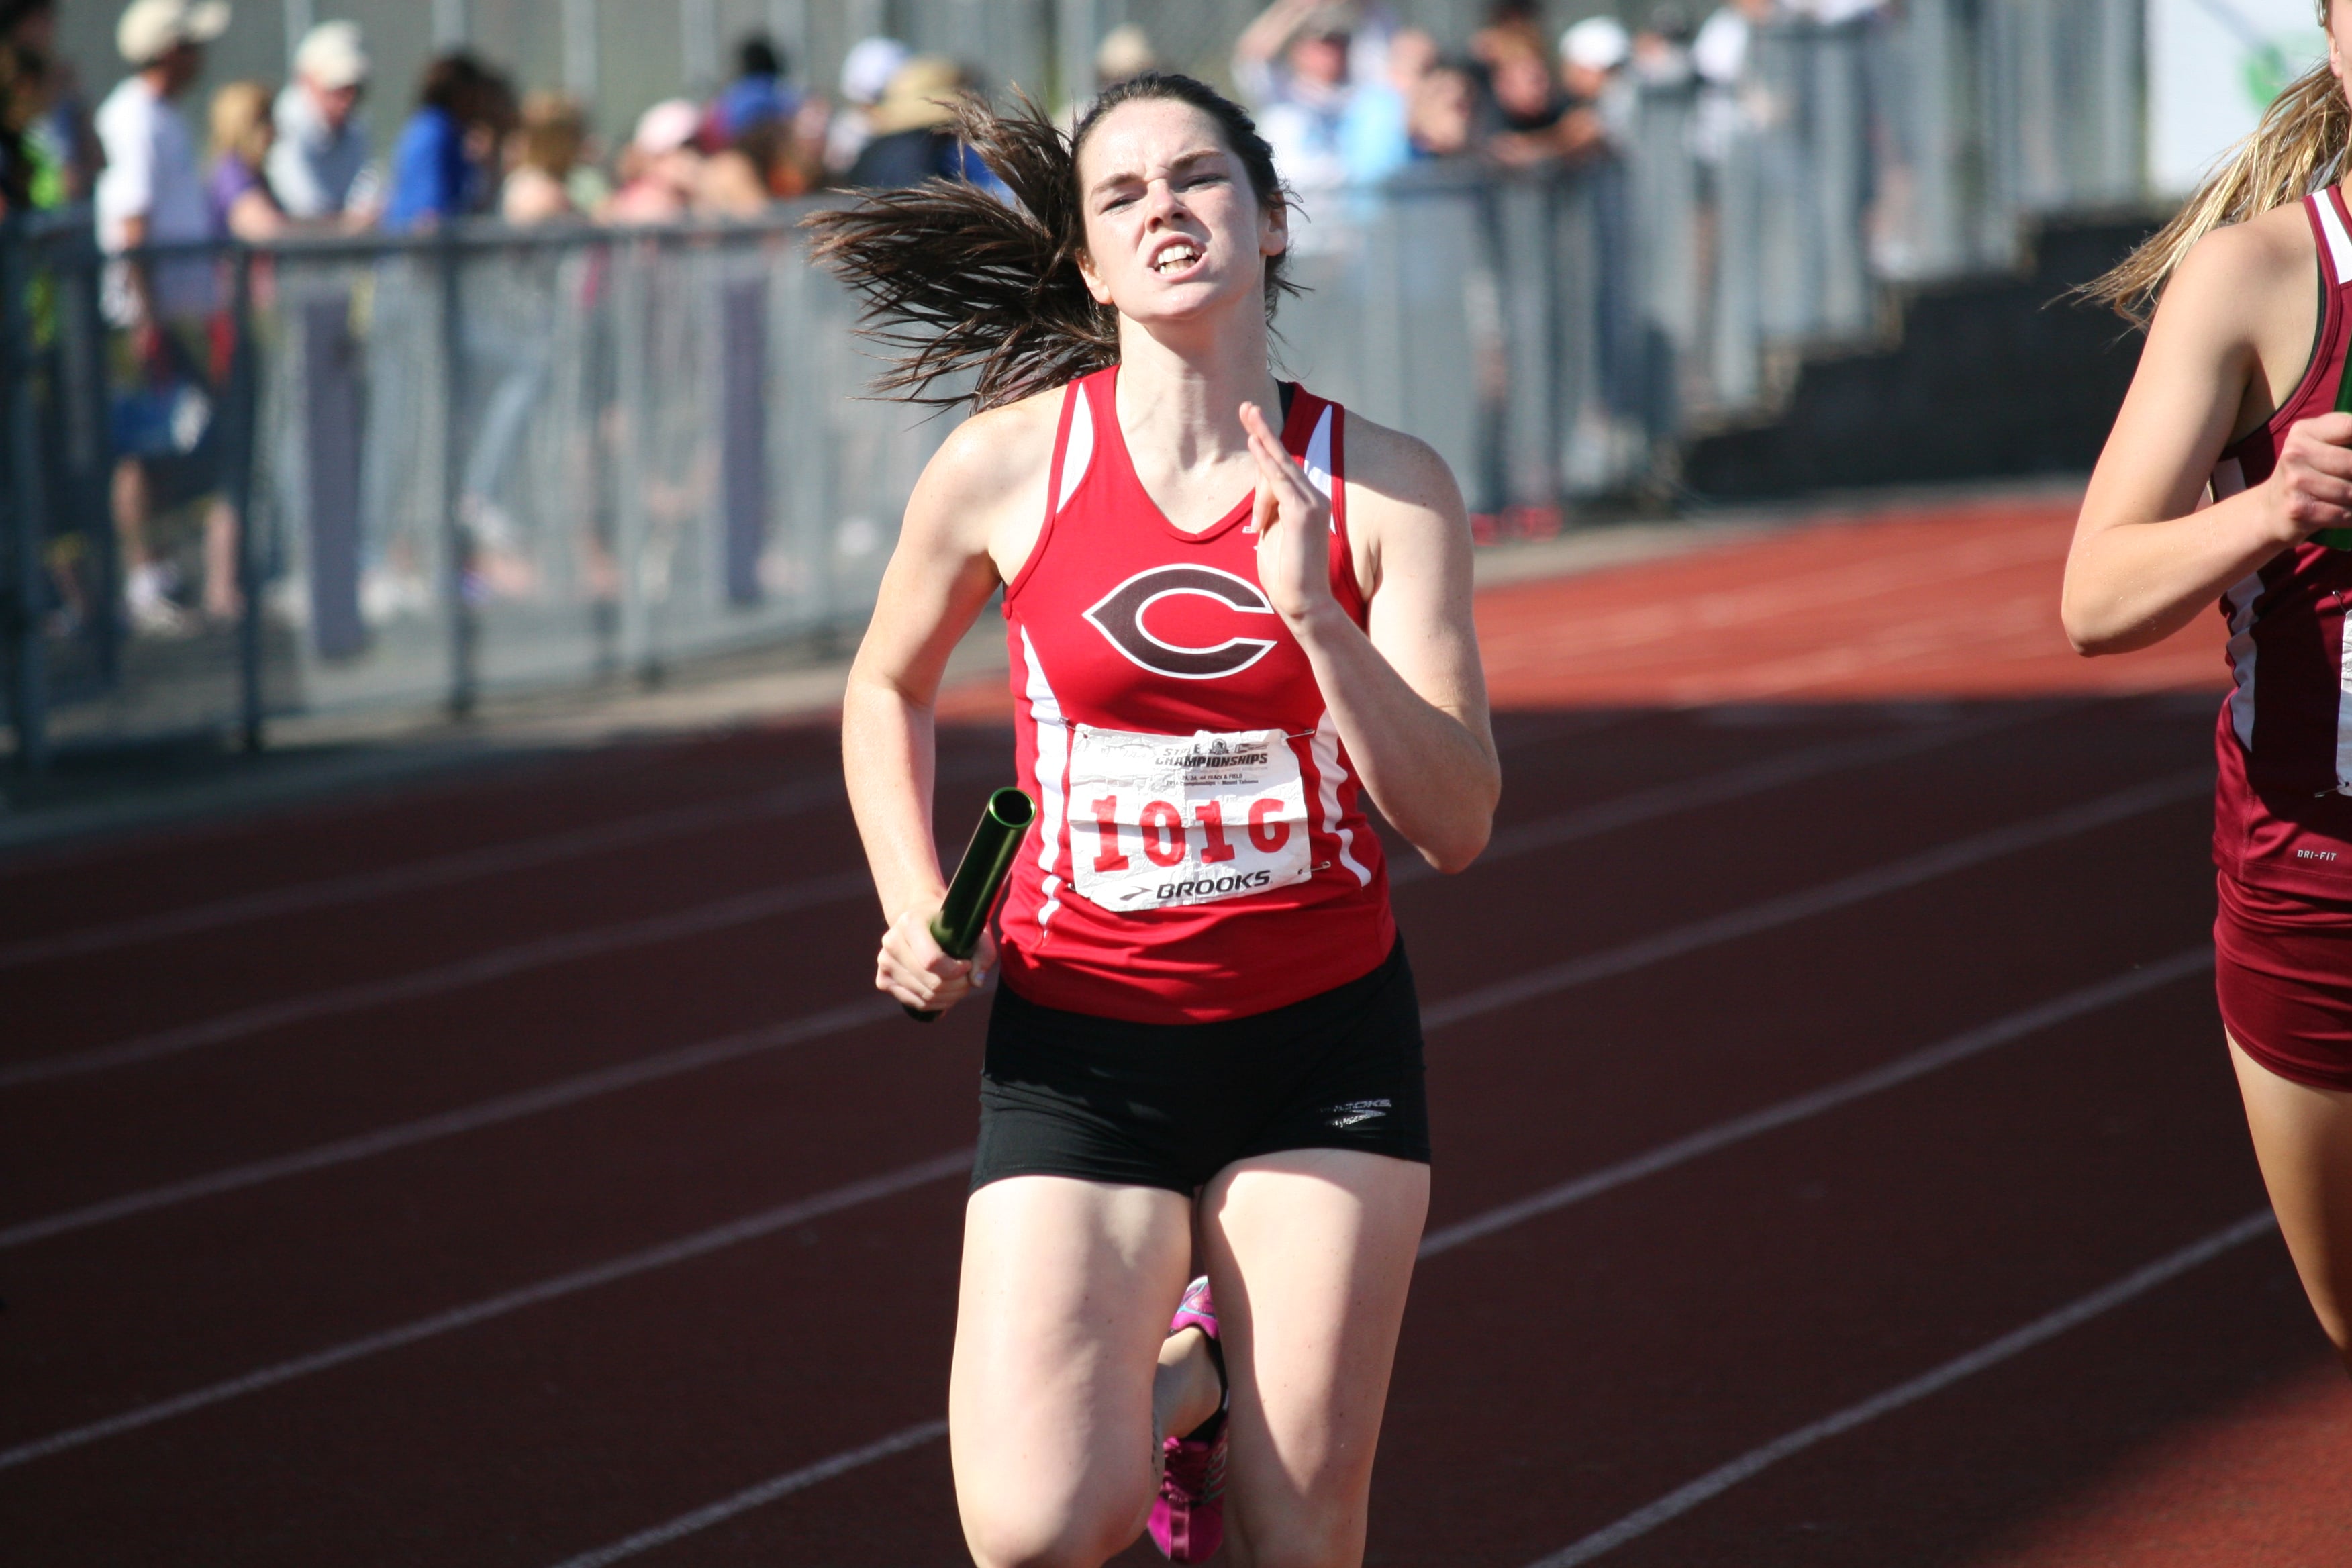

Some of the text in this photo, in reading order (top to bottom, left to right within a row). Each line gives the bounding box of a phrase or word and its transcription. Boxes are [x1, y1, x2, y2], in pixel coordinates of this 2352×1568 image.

[1081, 563, 1277, 679] C
[1155, 753, 1268, 767] CHAMPIONSHIPS
[1091, 795, 1290, 873] 1016
[2296, 849, 2337, 861] DRI-FIT
[1157, 869, 1271, 899] BROOKS
